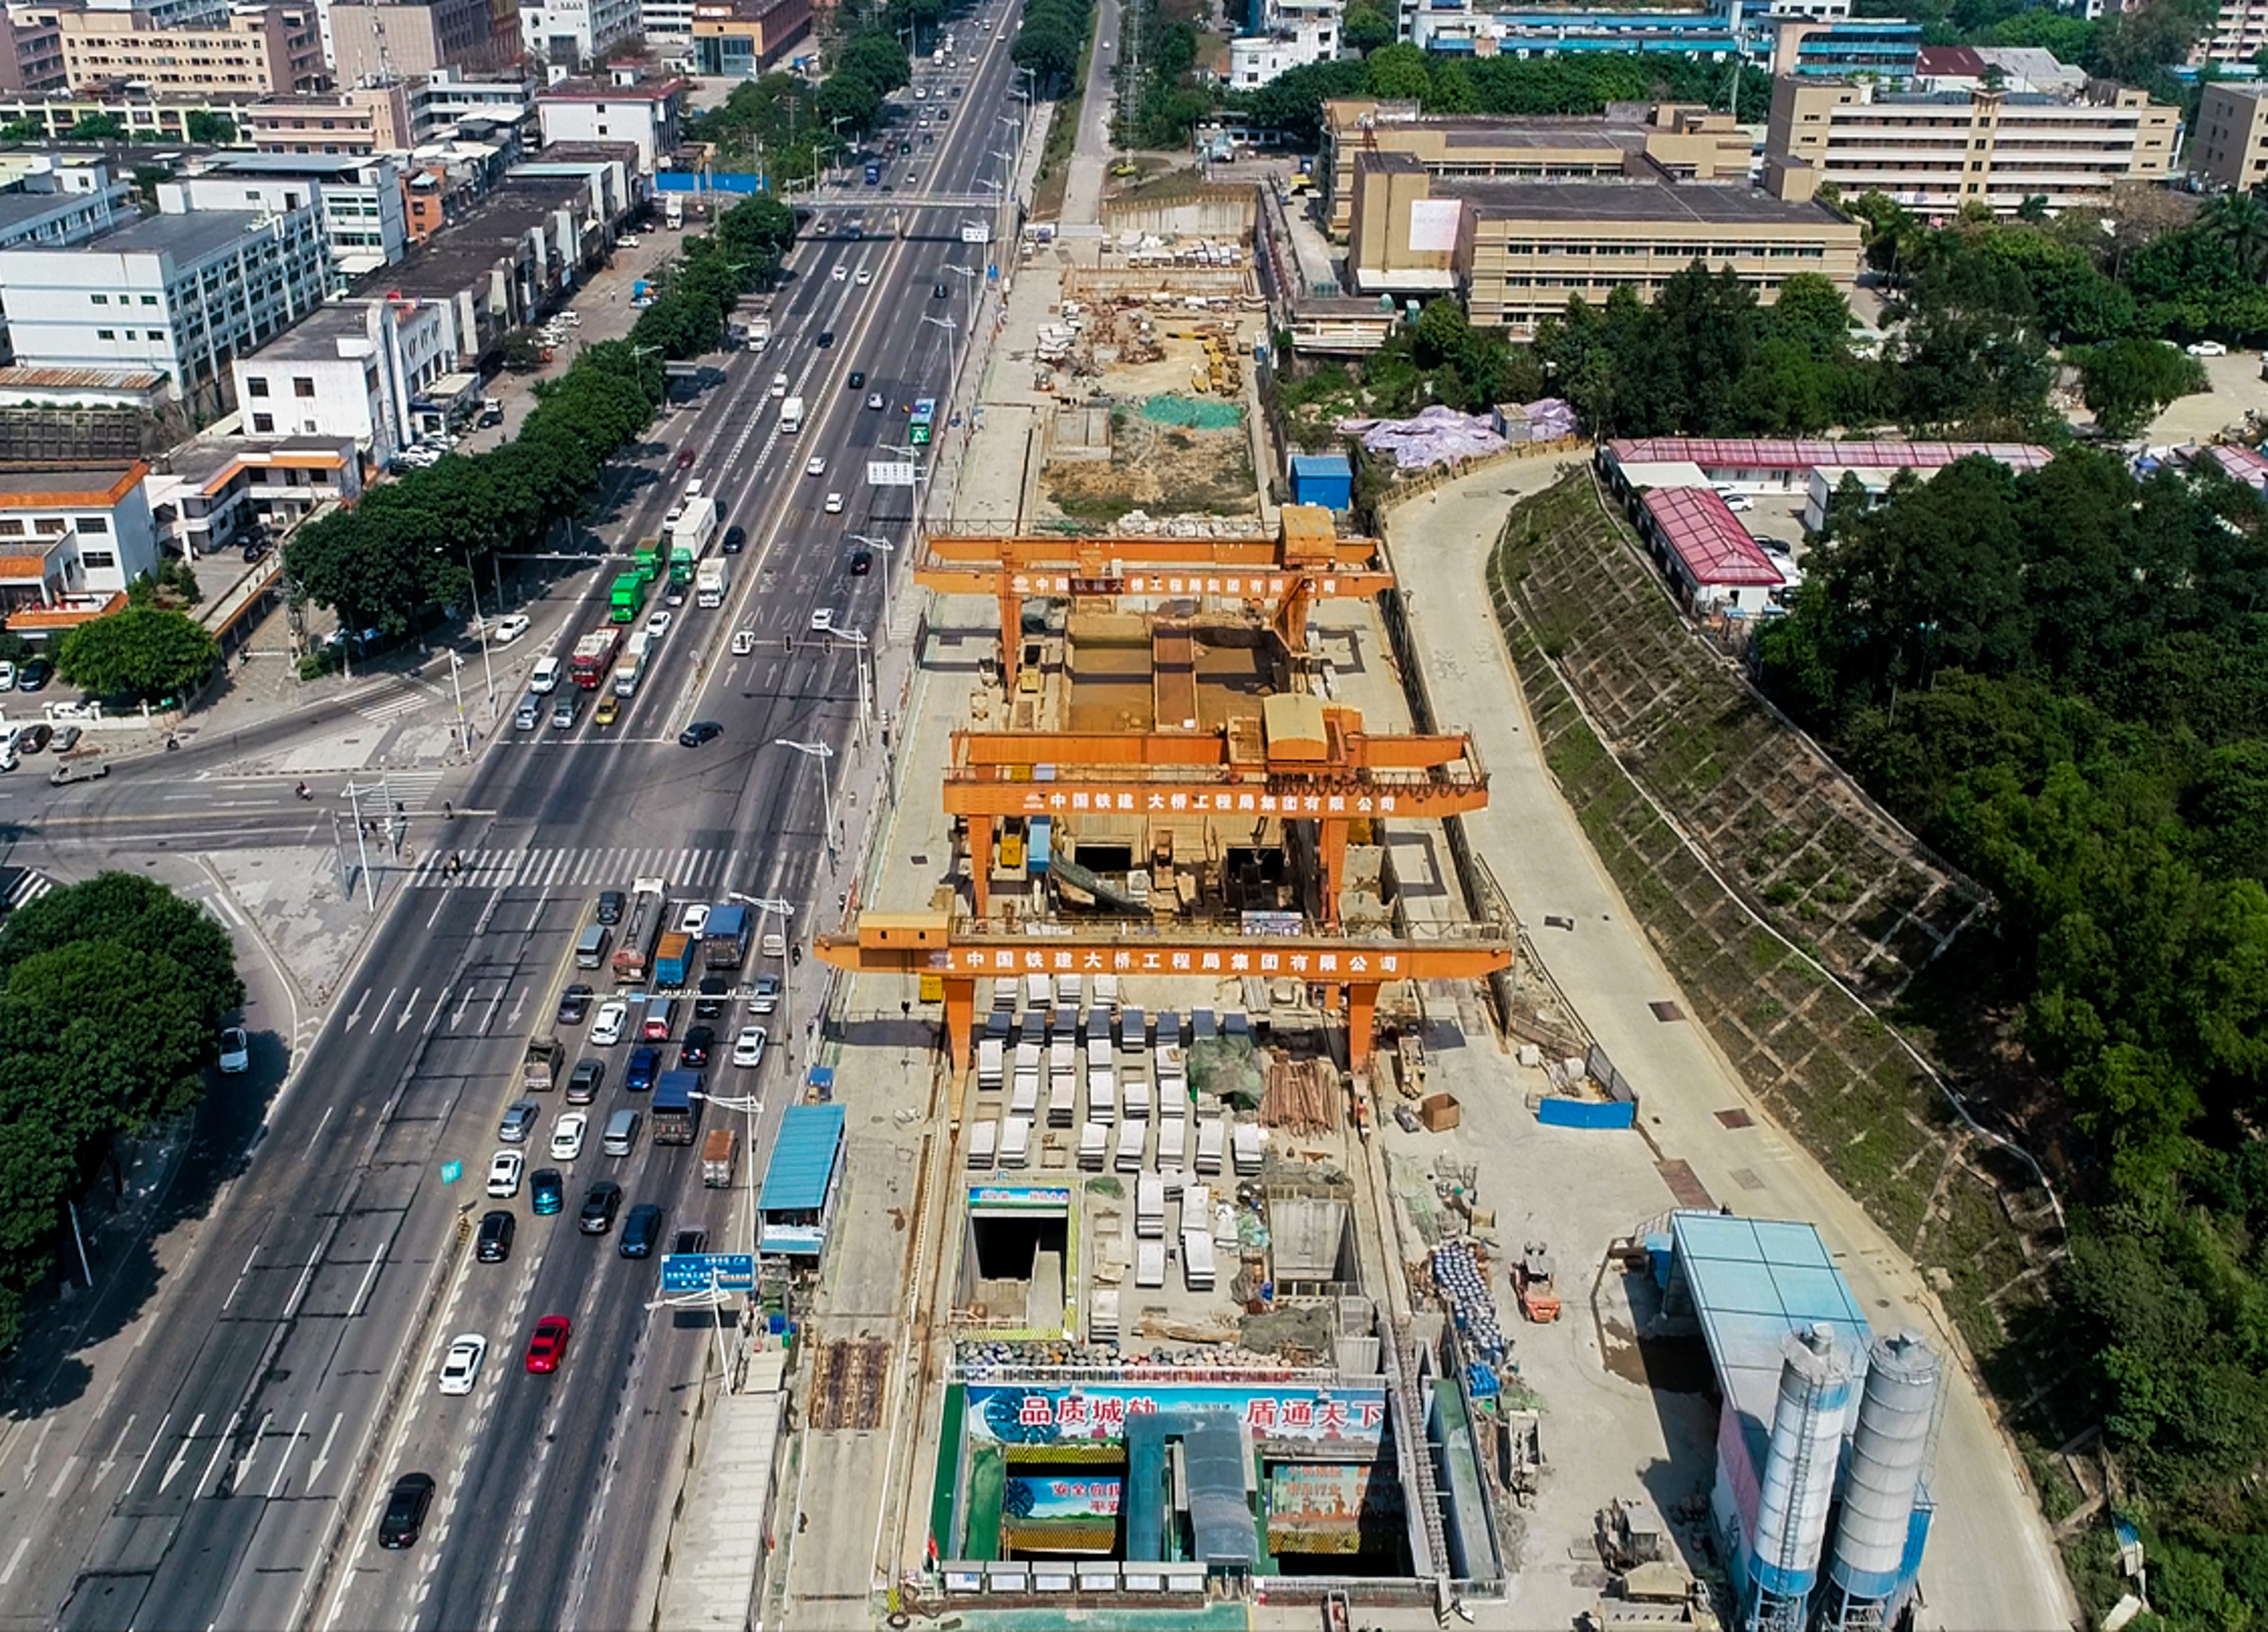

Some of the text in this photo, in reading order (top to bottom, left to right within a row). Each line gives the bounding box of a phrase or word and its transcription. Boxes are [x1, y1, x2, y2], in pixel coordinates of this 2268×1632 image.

[1050, 792, 1396, 811] 中国铁建大桥工程局集团有限公司
[966, 951, 1397, 972] 中国铁建大桥工程局集团有限公司
[1248, 1399, 1383, 1428] 盾通天下
